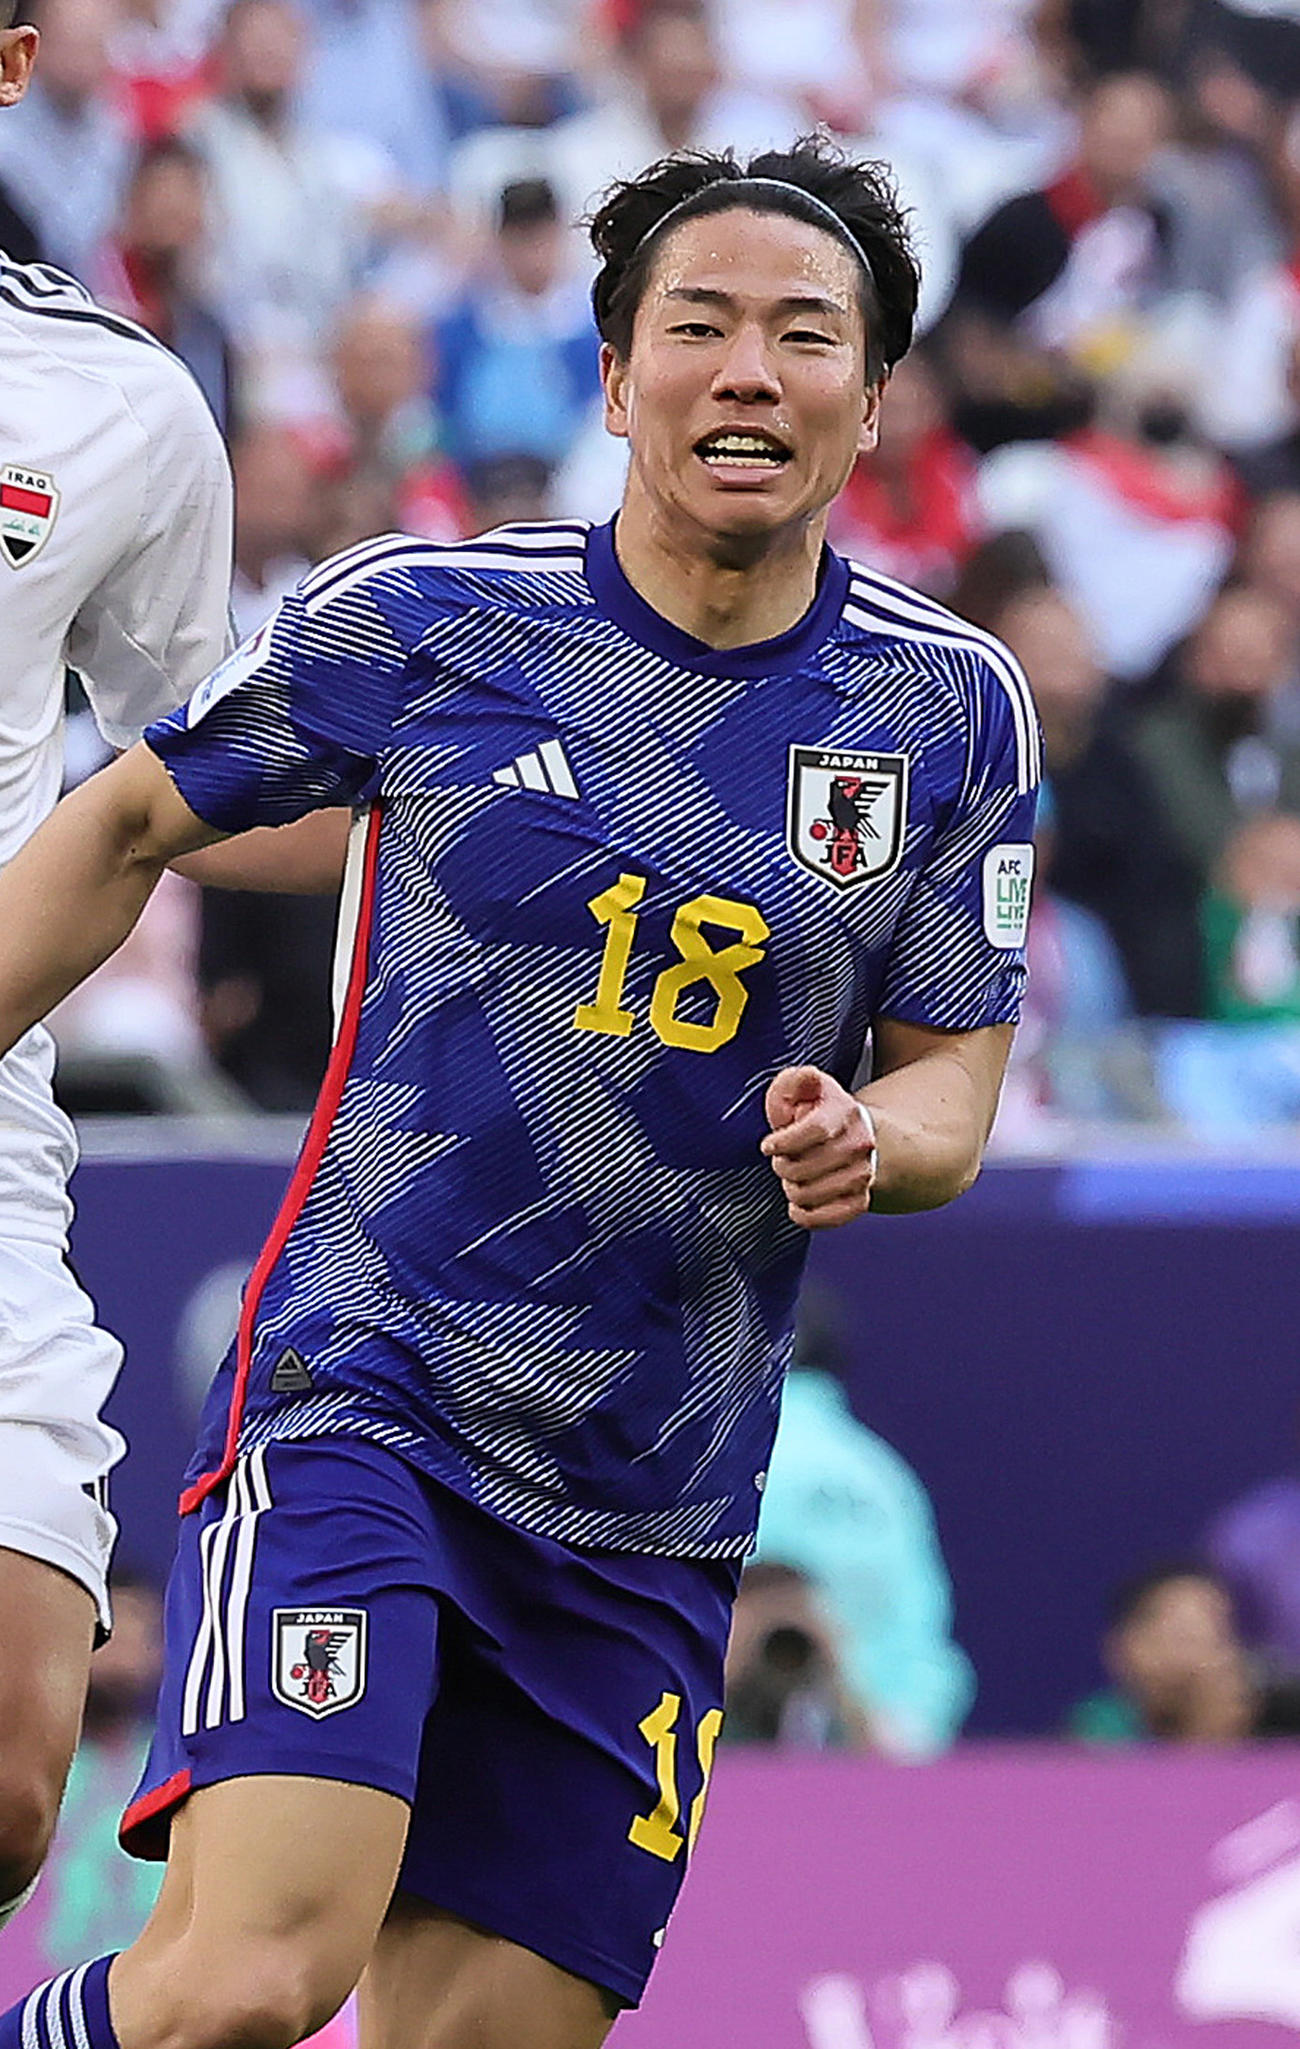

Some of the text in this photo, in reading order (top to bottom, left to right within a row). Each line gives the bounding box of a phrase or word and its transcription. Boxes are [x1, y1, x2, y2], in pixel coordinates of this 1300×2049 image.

[8, 471, 47, 490] IRAQ
[819, 754, 879, 770] JAPAN
[819, 844, 868, 867] JFA
[998, 860, 1021, 875] AFC
[573, 873, 771, 1054] 18
[296, 1613, 344, 1624] JAPAN
